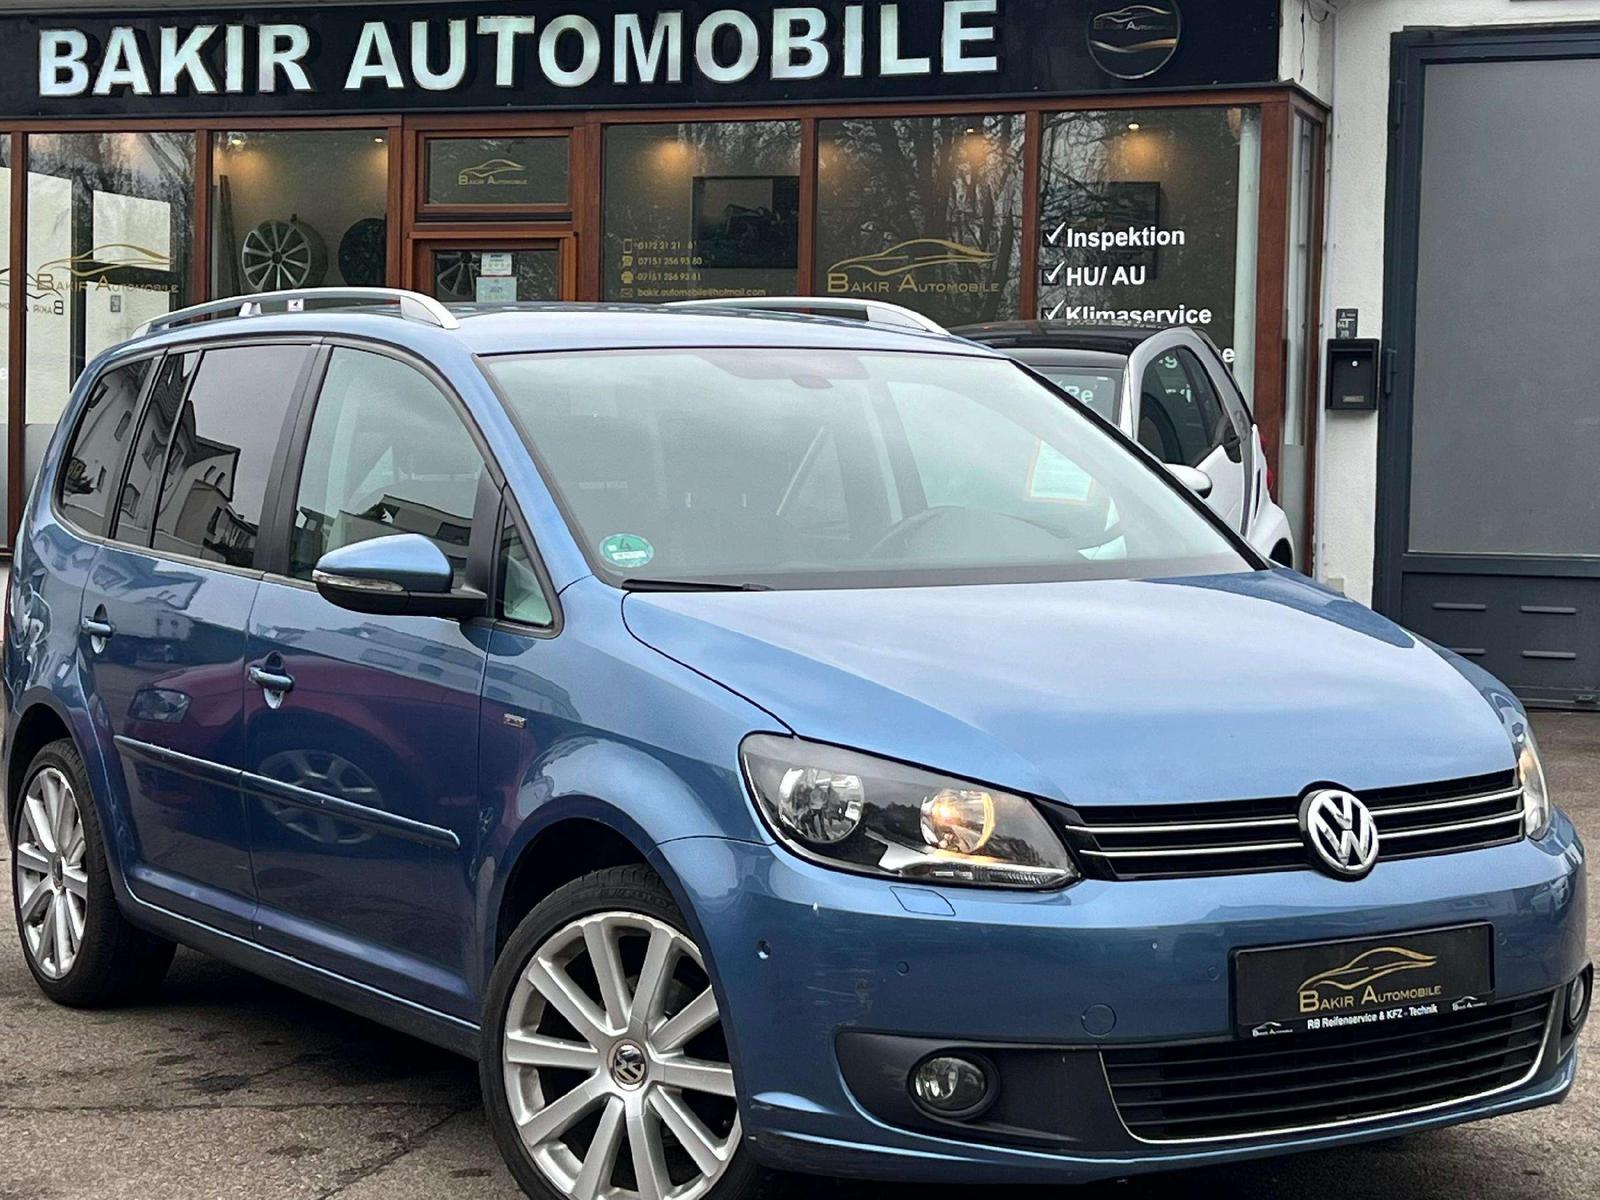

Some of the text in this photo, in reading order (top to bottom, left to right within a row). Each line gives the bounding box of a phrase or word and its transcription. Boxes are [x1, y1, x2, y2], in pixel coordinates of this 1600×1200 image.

[39, 0, 998, 96] BAKIR AUTOMOBILE
[1066, 227, 1185, 251] Inspektion
[827, 273, 1000, 293] BAKIR AUTOMOBILE
[1066, 265, 1146, 286] HU/ AU
[1066, 305, 1213, 324] Klimaservice
[1299, 985, 1442, 1013] BAKIR AUTOMOBILE
[1322, 1012, 1377, 1028] Reifenservice
[1386, 1008, 1403, 1020] KFZ
[1409, 1003, 1439, 1017] Technik
